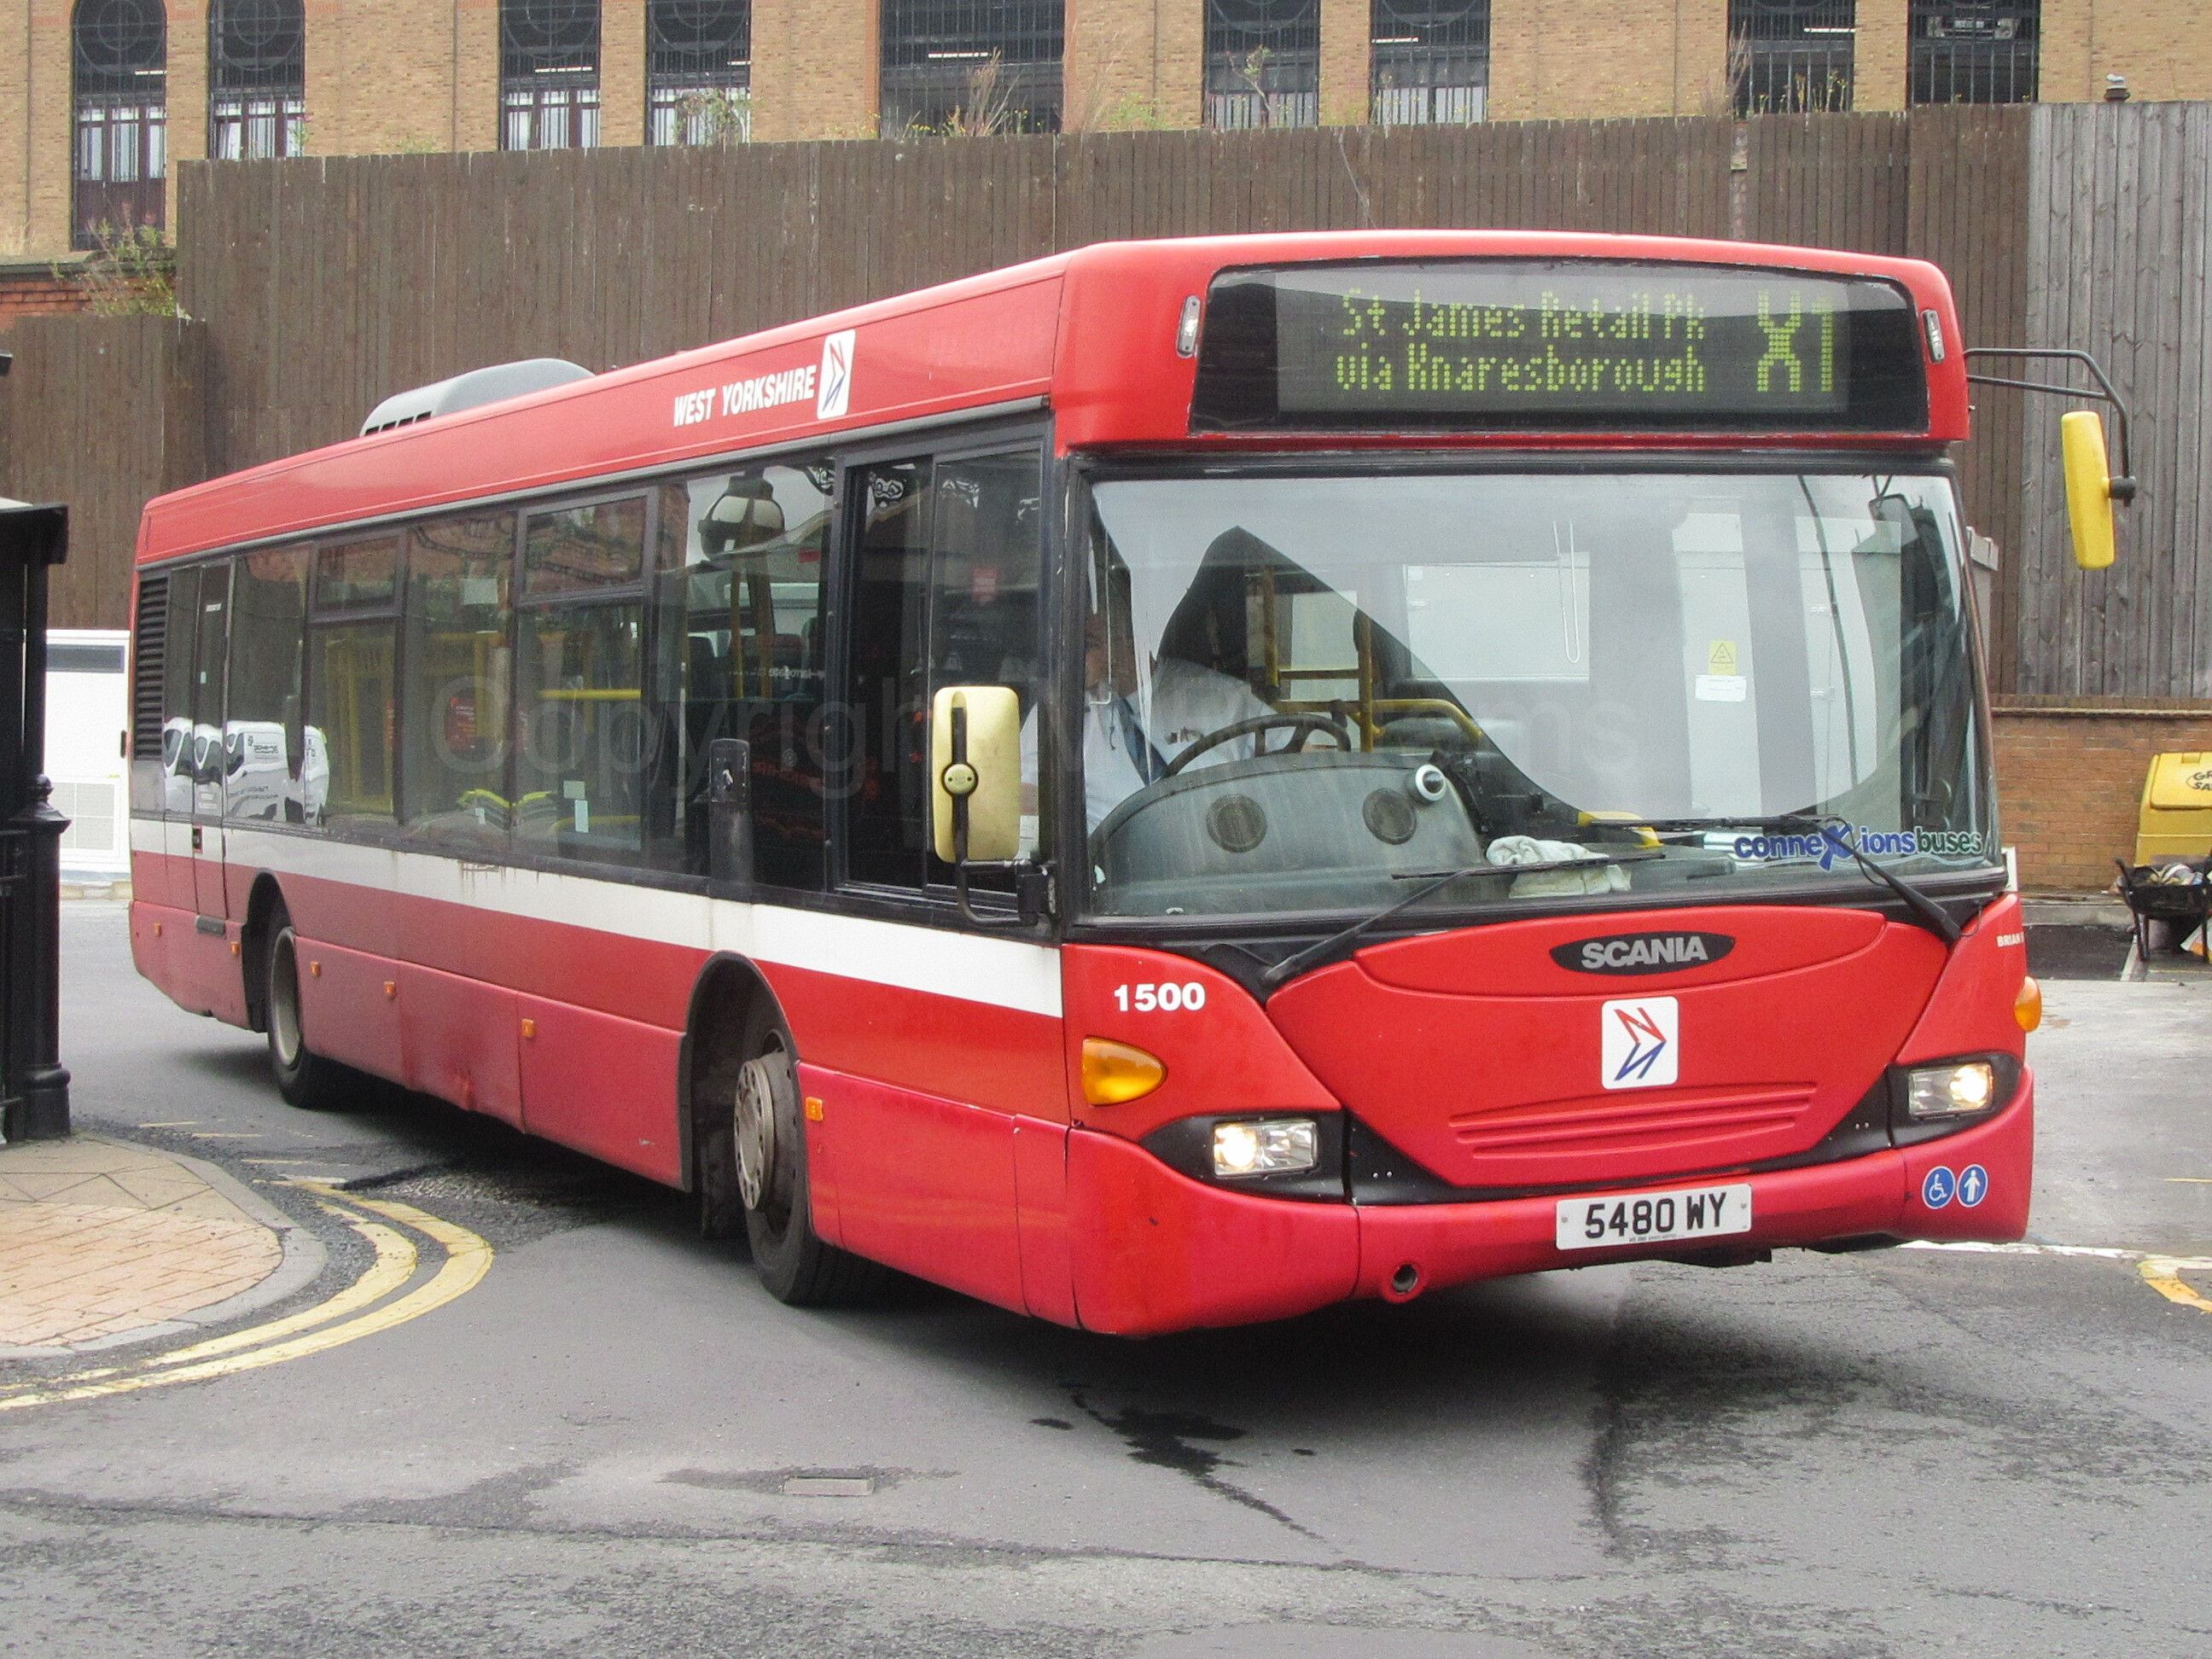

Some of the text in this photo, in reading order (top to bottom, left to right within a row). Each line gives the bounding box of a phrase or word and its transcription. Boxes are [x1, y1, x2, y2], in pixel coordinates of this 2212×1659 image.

[1343, 288, 1387, 335] St
[1402, 288, 1525, 337] James
[1540, 291, 1650, 339] Retail
[1336, 341, 1705, 392] via Knaresborough
[1755, 289, 1835, 393] X1
[673, 364, 817, 427] WEST YORKSHIRE
[1580, 935, 1708, 969] SCANIA
[1114, 982, 1206, 1011] 1500
[1585, 1191, 1726, 1238] 5480 WY
